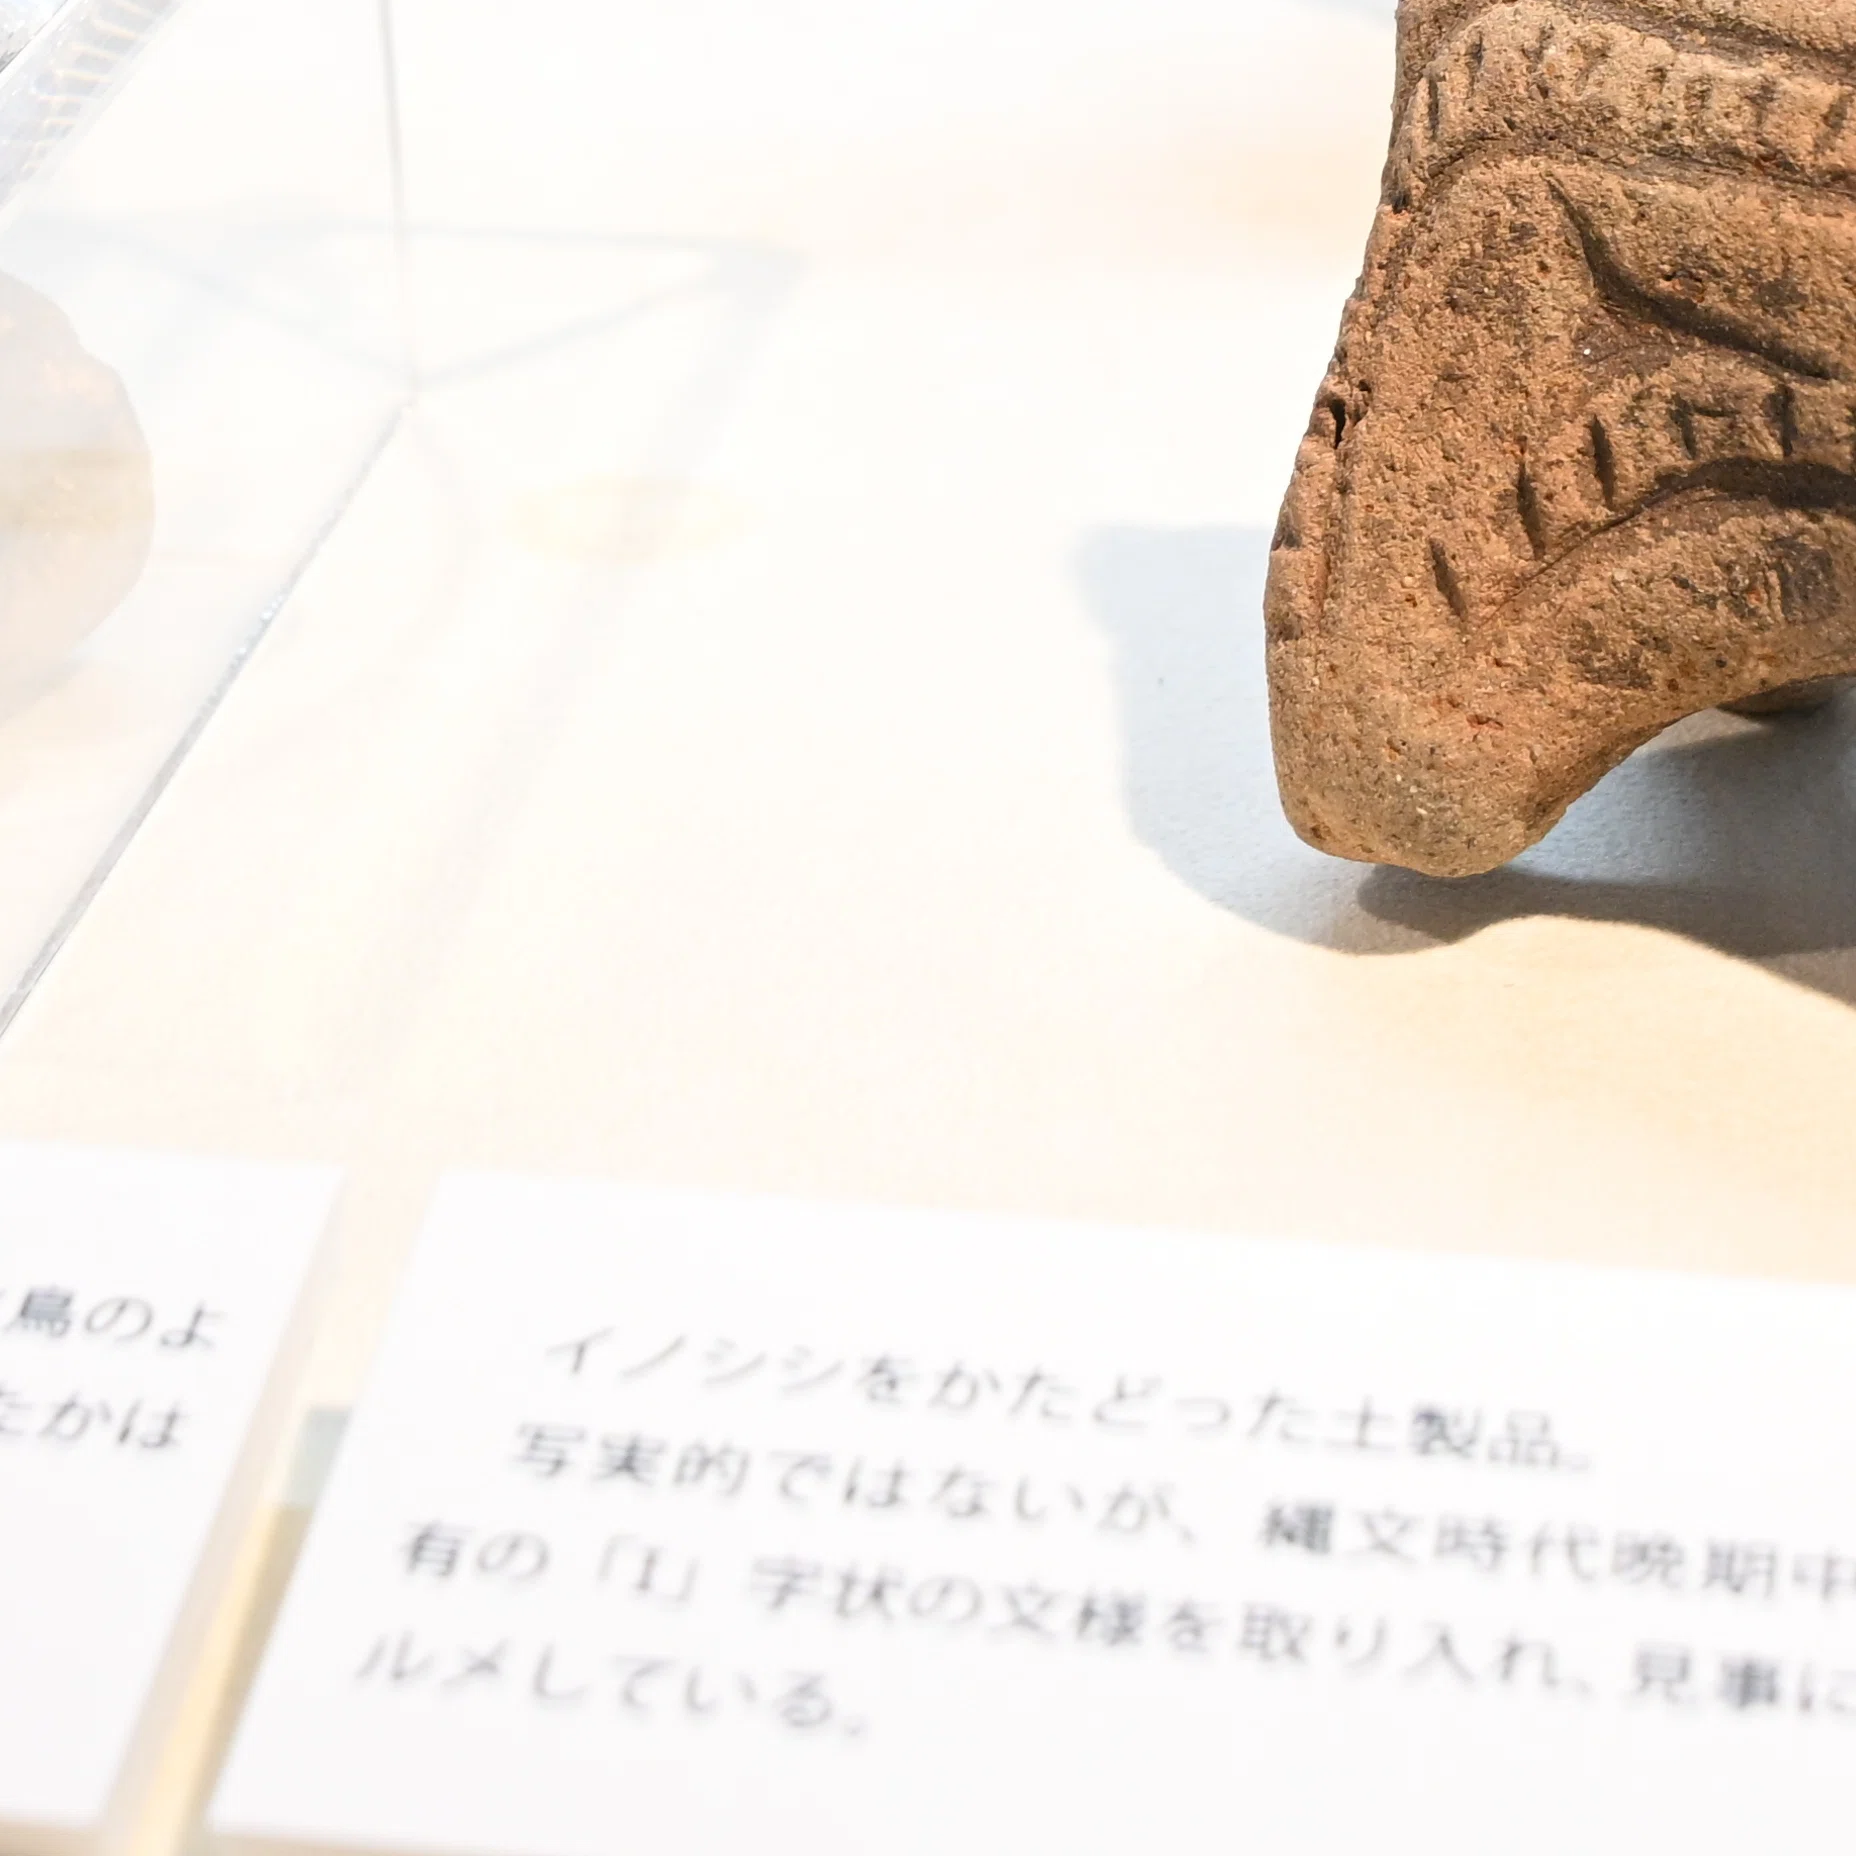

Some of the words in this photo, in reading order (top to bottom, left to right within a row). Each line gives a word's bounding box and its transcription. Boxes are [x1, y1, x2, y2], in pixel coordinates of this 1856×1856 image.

[547, 1326, 1592, 1472] イノシシをかたどった土製品。
[356, 1631, 871, 1741] ルメしている。
